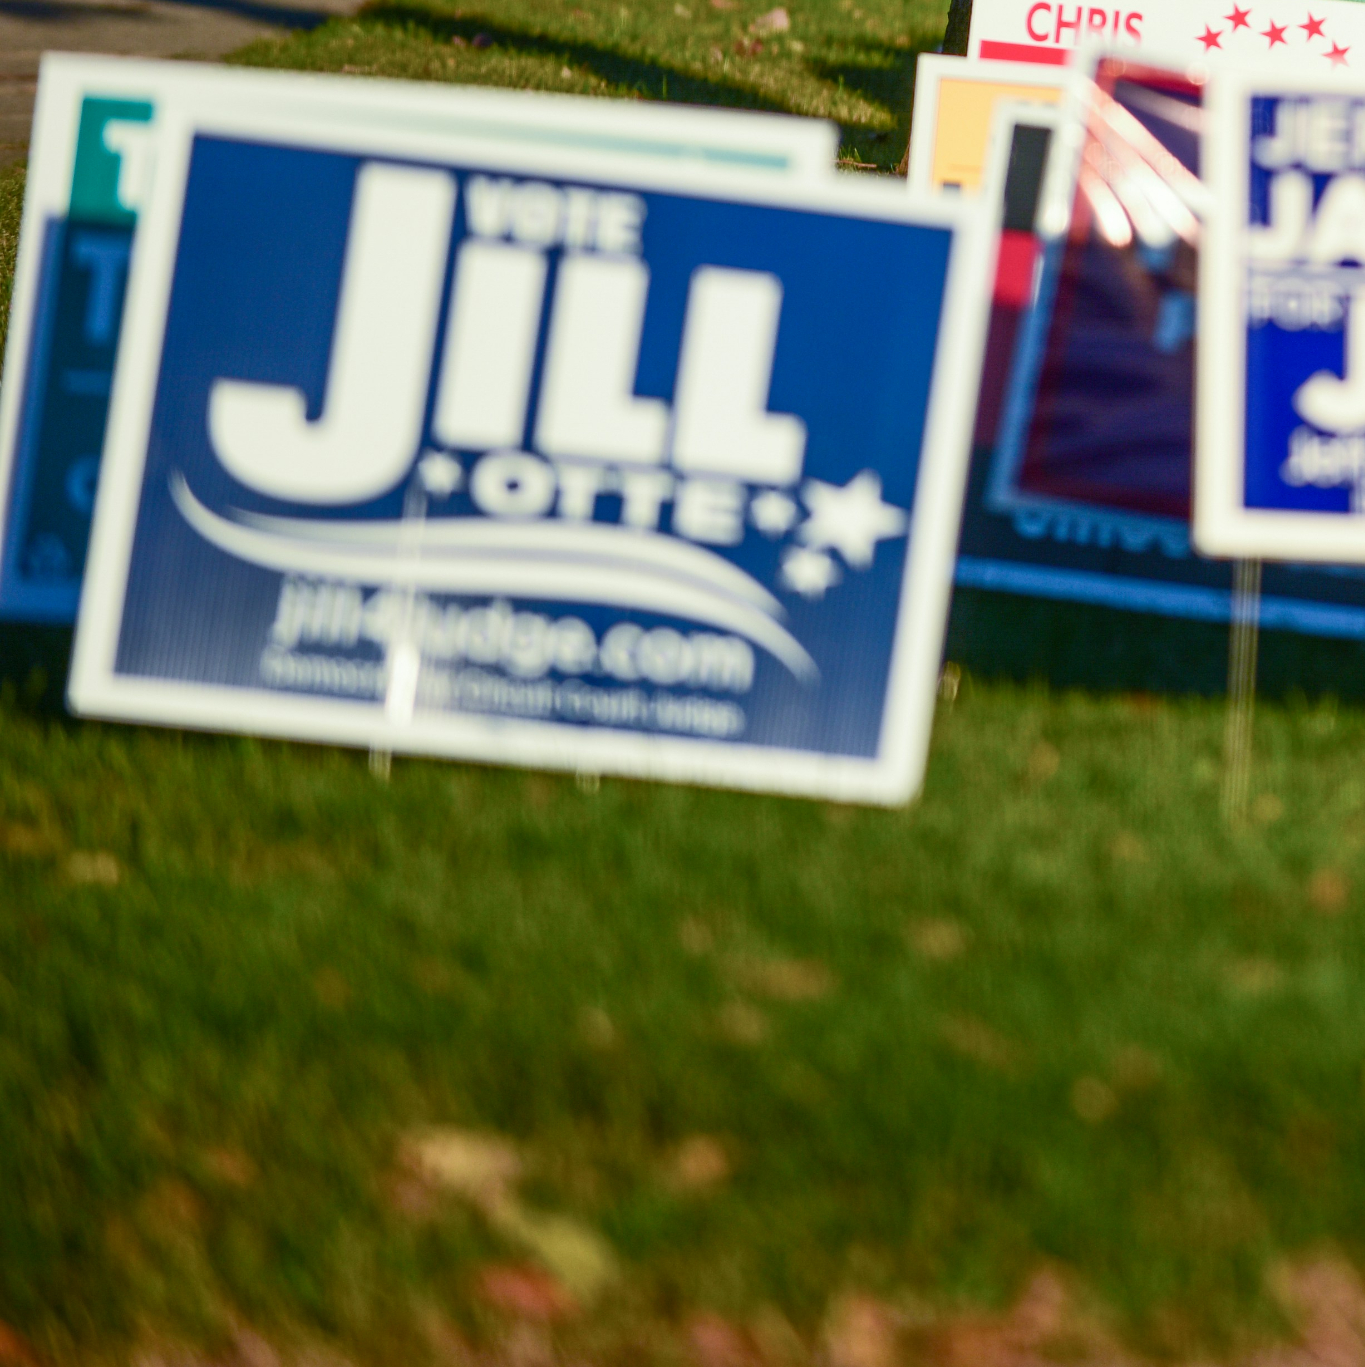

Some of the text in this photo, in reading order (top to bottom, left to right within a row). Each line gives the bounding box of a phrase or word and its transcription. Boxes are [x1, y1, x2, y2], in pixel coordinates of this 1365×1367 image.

[1026, 0, 1143, 48] CHRIS
[465, 173, 647, 254] VOTE
[207, 160, 807, 505] JILL
[1247, 278, 1344, 331] FOR
[470, 448, 747, 545] OTTE
